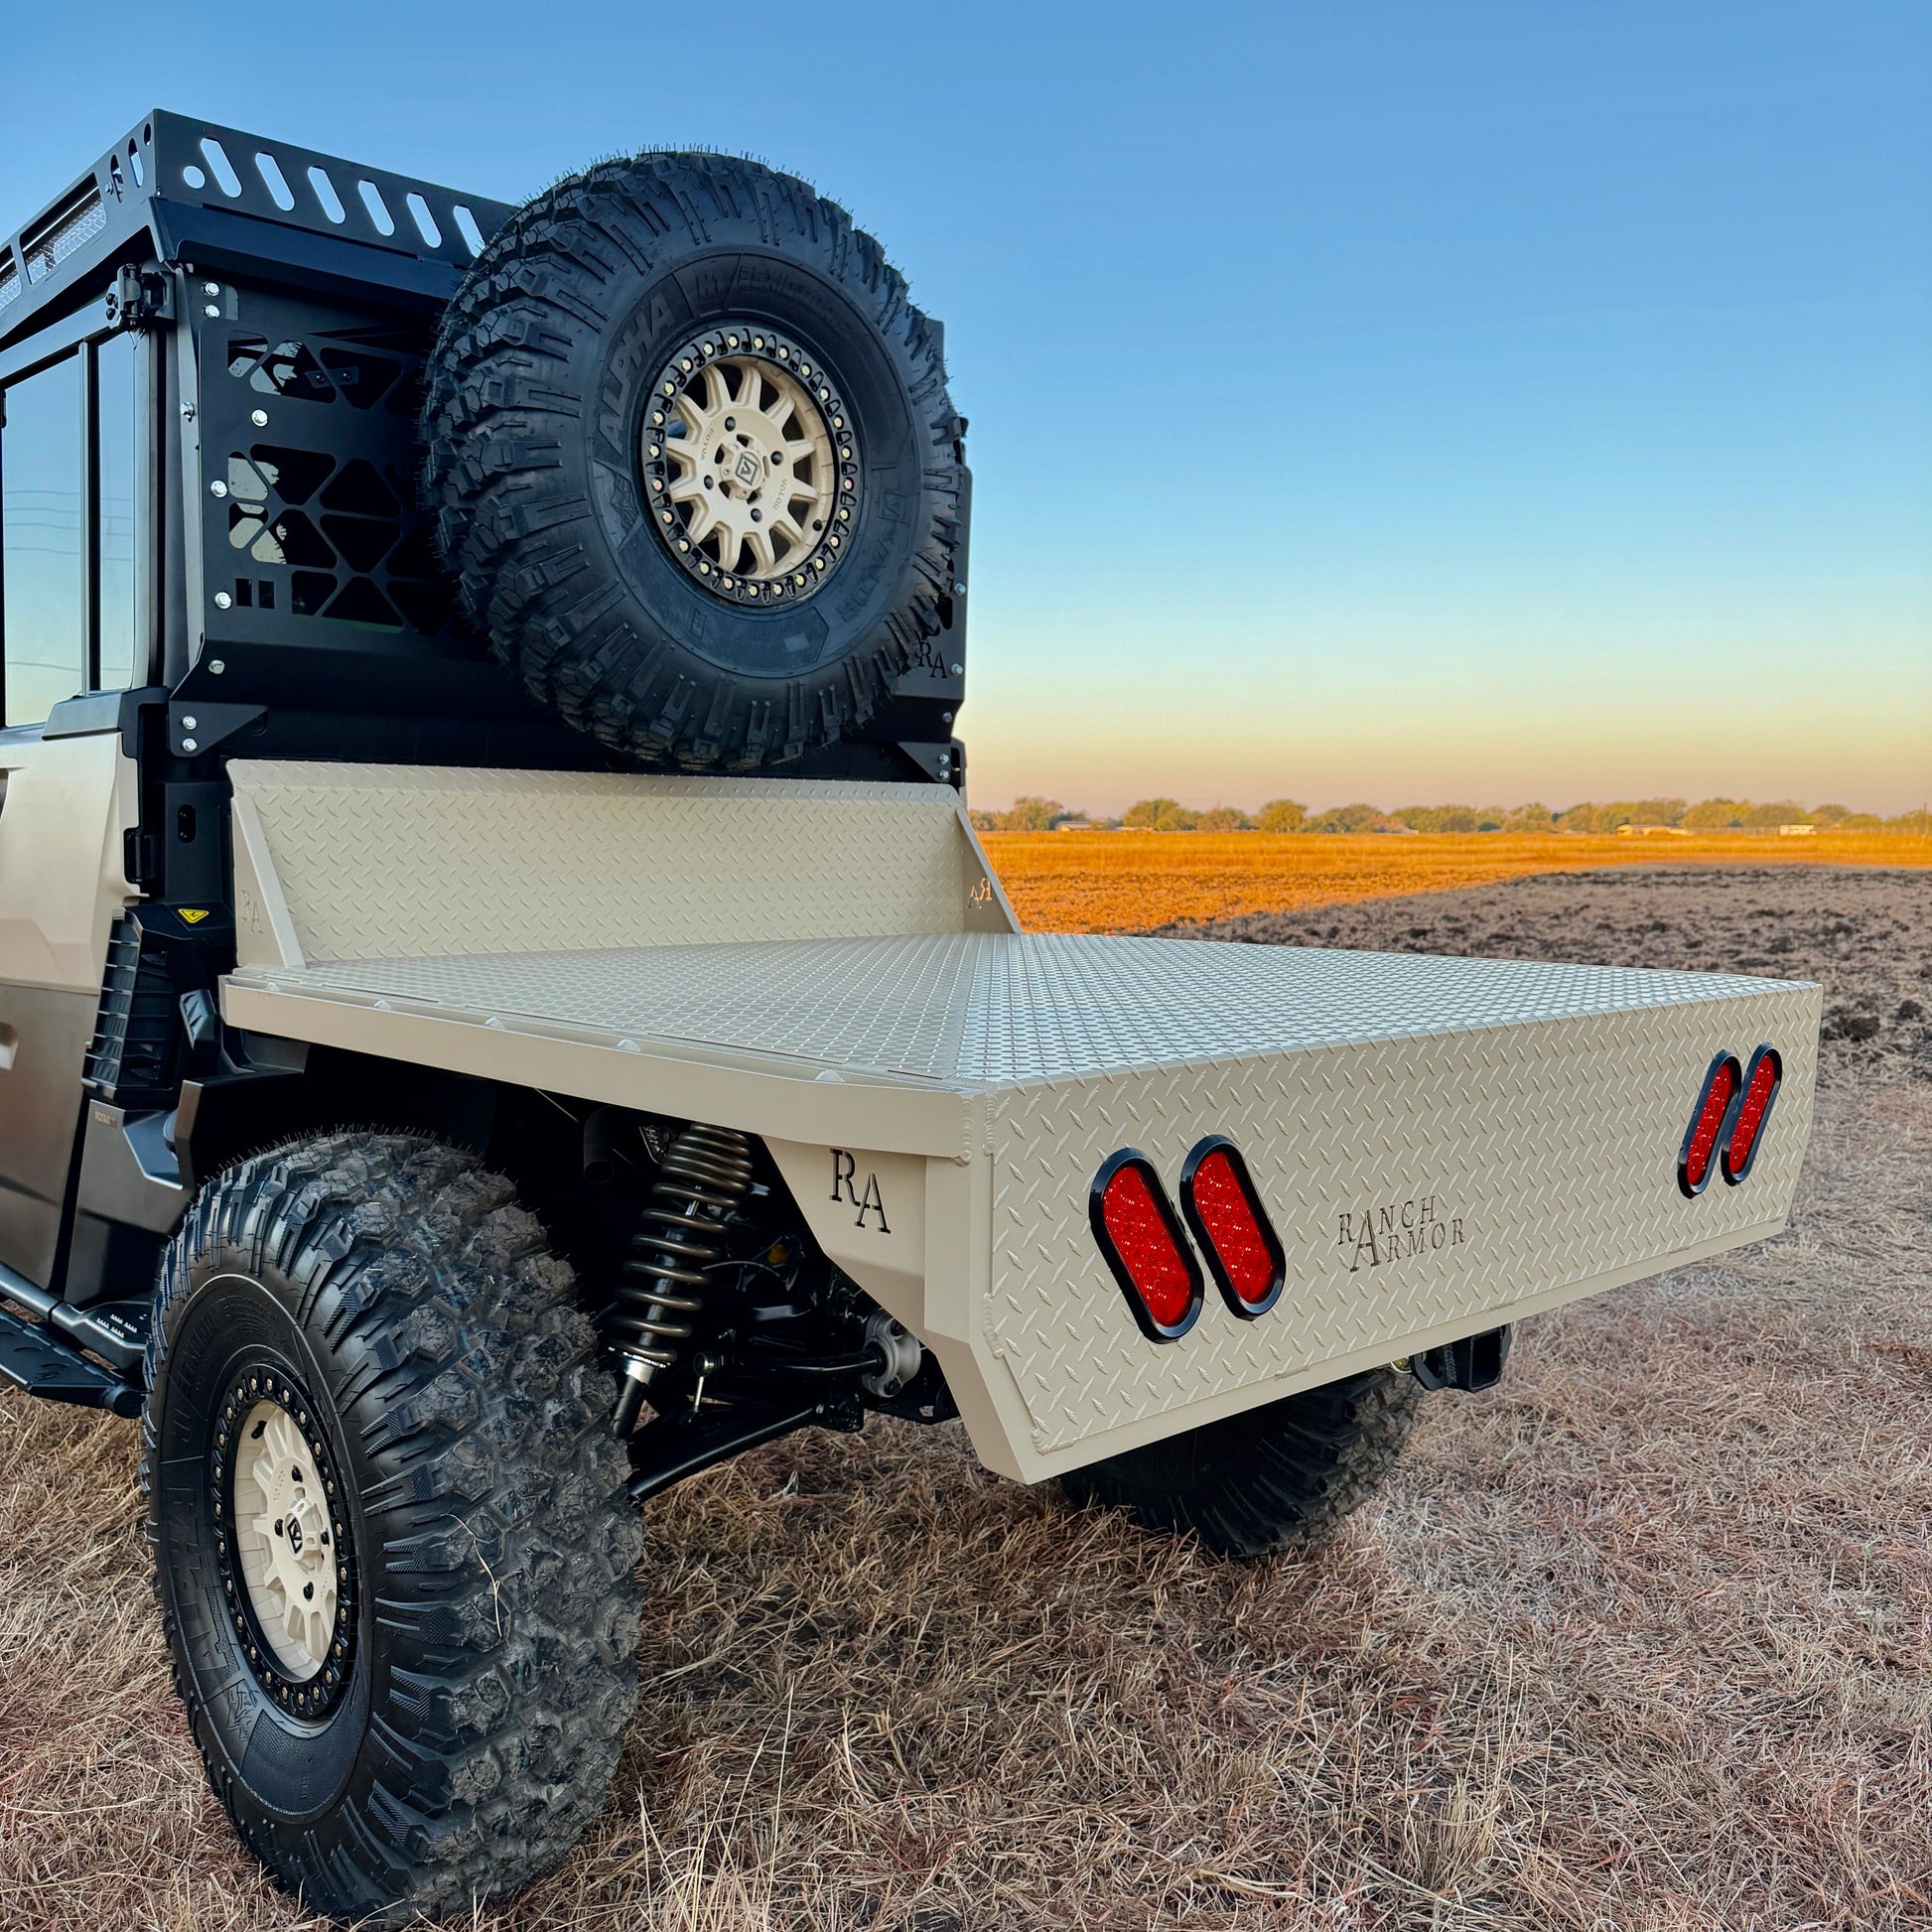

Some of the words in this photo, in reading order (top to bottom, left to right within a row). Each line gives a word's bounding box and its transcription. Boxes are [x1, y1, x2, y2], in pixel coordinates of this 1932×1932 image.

[917, 641, 947, 679] RA
[829, 1148, 891, 1234] RA
[1337, 1194, 1436, 1273] RANCH
